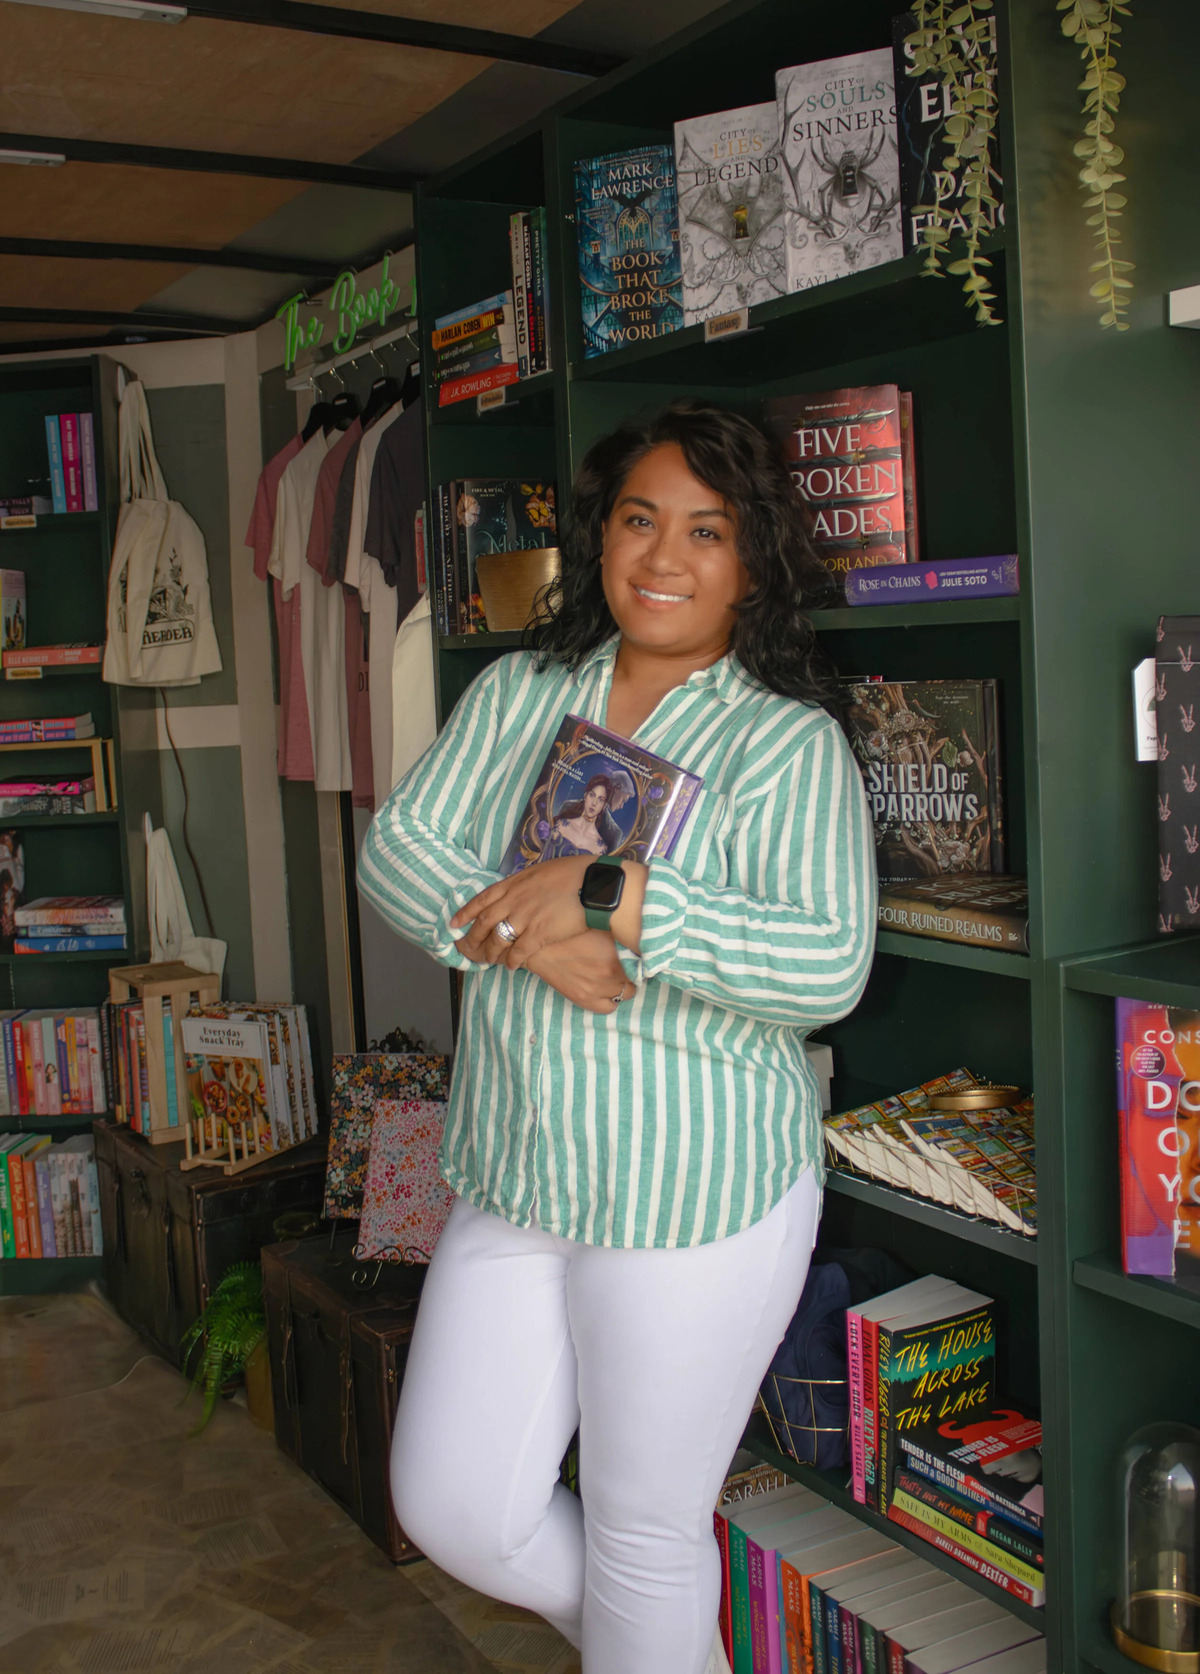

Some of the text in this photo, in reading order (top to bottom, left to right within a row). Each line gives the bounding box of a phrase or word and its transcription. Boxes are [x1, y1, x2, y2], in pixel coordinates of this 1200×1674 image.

[805, 80, 887, 113] SOULS
[824, 77, 856, 92] CITY
[792, 104, 898, 142] SINNERS
[836, 106, 854, 115] AND
[713, 134, 763, 159] LIES
[719, 129, 748, 142] CITY
[608, 162, 653, 182] MARK
[695, 155, 779, 186] LEGEND
[730, 154, 746, 162] AND
[591, 175, 674, 201] LAWRENCE
[624, 239, 646, 250] THE
[612, 251, 663, 272] BOOK
[614, 269, 661, 290] THAT
[275, 256, 400, 370] The Book
[515, 275, 526, 345] LEGEND
[610, 289, 669, 311] BROKE
[440, 312, 495, 343] HARLAN COBEN WIN
[628, 309, 652, 322] THE
[608, 322, 675, 343] WORLD
[461, 377, 492, 394] ROWLING
[792, 424, 863, 457] FIVE
[789, 462, 897, 501] ROKEN
[812, 506, 892, 538] ADES
[476, 530, 546, 555] Metal
[822, 555, 887, 573] ORLAND
[859, 578, 880, 591] ROSE
[888, 575, 921, 588] CHAINS
[941, 575, 988, 588] JULIE SOTO
[868, 760, 969, 793] SHIELD OF
[878, 907, 1003, 942] FOUR RUINED REALMS
[199, 1036, 244, 1048] Snack Tray
[203, 1027, 241, 1038] Everyday
[1143, 1029, 1200, 1044] CONS
[1147, 1080, 1200, 1110] DO
[850, 1321, 858, 1349] LOCK
[895, 1342, 930, 1372] THE
[937, 1318, 993, 1363] HOUSE
[879, 1333, 891, 1372] RILEY
[851, 1351, 860, 1386] EVERY
[911, 1355, 985, 1399] ACROSS
[852, 1389, 861, 1418] DOOR
[863, 1330, 875, 1485] FINAL GIRLS RILEY SAGER
[879, 1373, 891, 1418] SAGER
[938, 1381, 990, 1419] LAKE
[900, 1438, 924, 1464] TENDER
[925, 1453, 932, 1465] IS
[933, 1456, 945, 1472] THE
[946, 1463, 966, 1483] FLESH
[948, 1435, 999, 1458] TENDER IS
[958, 1442, 1010, 1465] THE FLESH
[855, 1451, 863, 1478] SAGER
[723, 1476, 778, 1504] SARAH
[910, 1456, 987, 1505] SUCH a GOOD MOTHER
[899, 1475, 1033, 1557] THAT'S NOT MY NAME MEGAN LALLY
[900, 1496, 1036, 1582] SAFE IN MY ARMS Sara Shepard
[935, 1536, 953, 1552] DARKLY
[953, 1547, 979, 1569] DREAMING
[980, 1562, 1009, 1588] DEXTER
